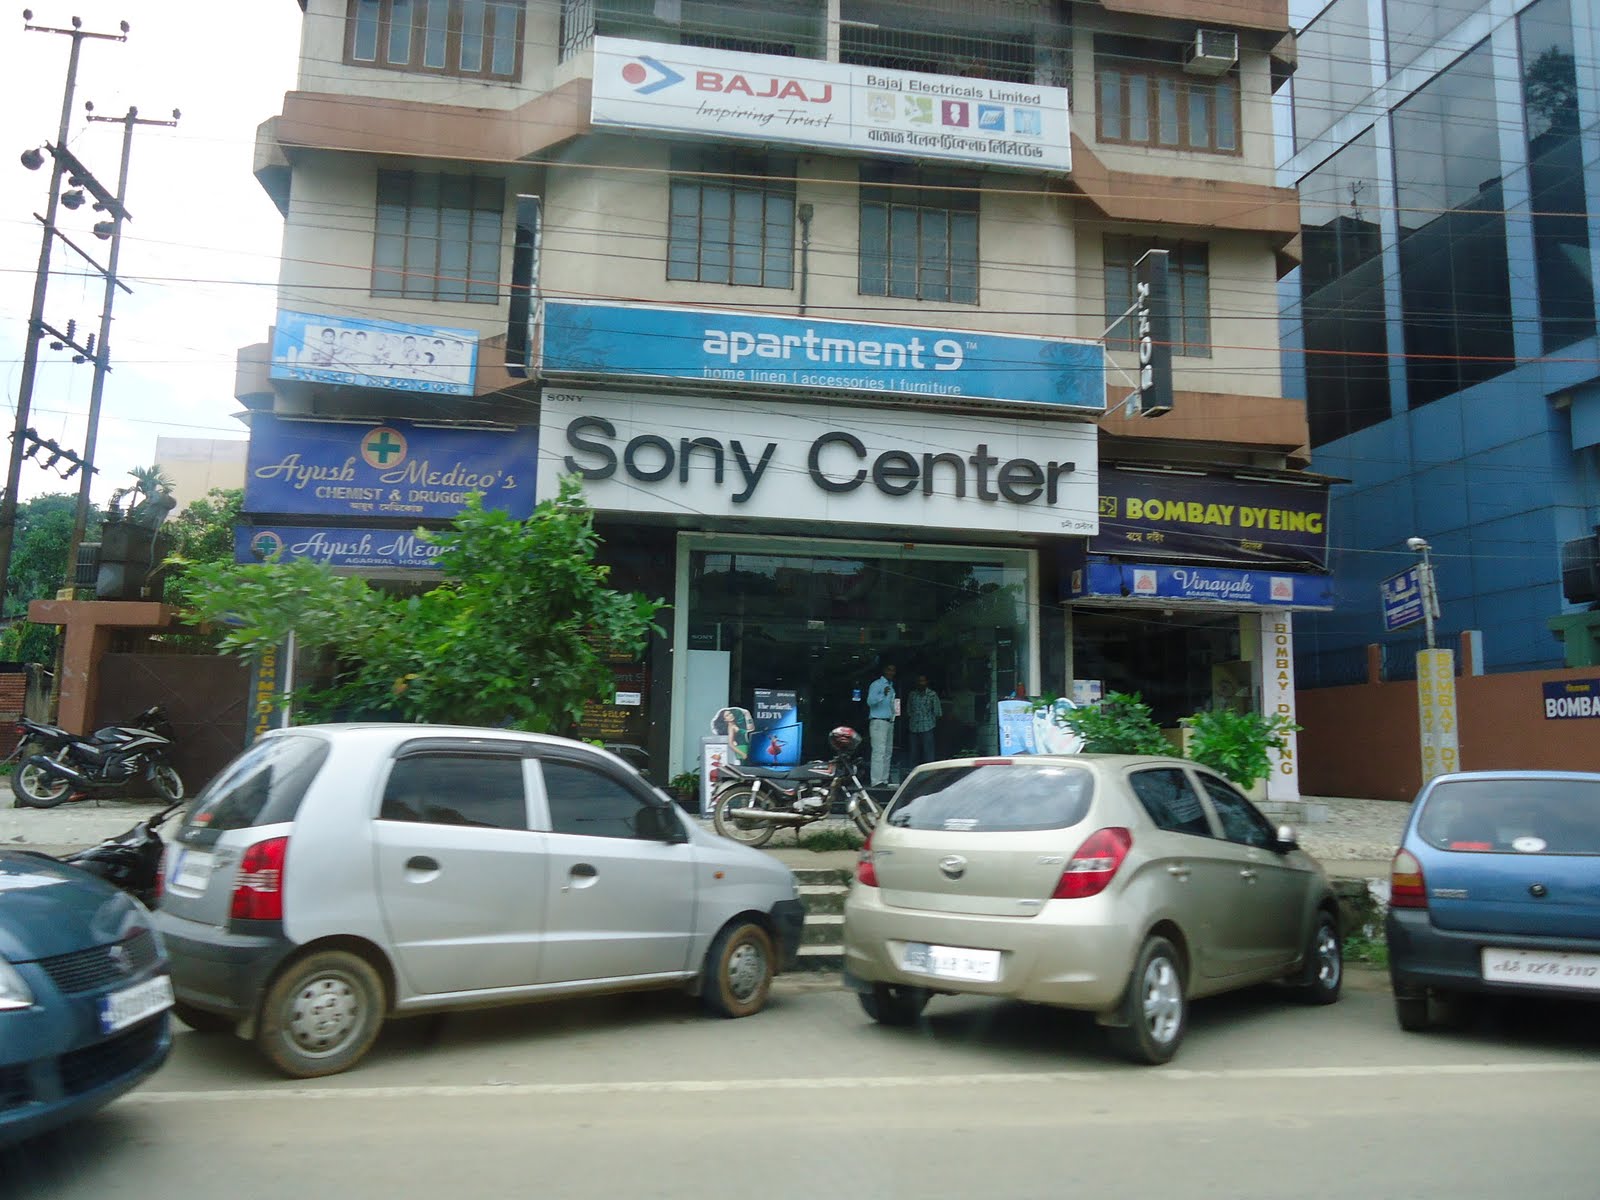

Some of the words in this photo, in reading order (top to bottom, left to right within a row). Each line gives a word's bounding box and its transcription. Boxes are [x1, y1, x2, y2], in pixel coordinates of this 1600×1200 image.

[696, 71, 833, 104] BAJAJ
[867, 75, 903, 92] Bajaj
[909, 79, 983, 99] Electricals
[989, 89, 1041, 105] Limited
[696, 100, 775, 127] Inspiring
[778, 108, 832, 128] Trust
[868, 129, 905, 145] বাজাজ
[703, 328, 926, 370] apartment
[933, 339, 964, 371] 9
[703, 365, 745, 381] home
[750, 367, 786, 384] linen
[801, 373, 885, 391] accessories
[900, 378, 961, 396] furniture
[547, 393, 585, 402] SONY
[254, 453, 357, 490] Ayush
[380, 460, 518, 489] Medico's
[564, 415, 777, 504] Sony
[807, 430, 1076, 505] Center
[315, 486, 384, 502] CHEMIST
[388, 488, 402, 502] &
[1126, 496, 1236, 526] BOMBAY
[1239, 505, 1323, 535] DYEING
[290, 531, 372, 563] Ayush
[345, 557, 395, 566] AGARWAL
[399, 558, 436, 567] HOUSE
[1172, 569, 1254, 598] Vinayak
[1274, 623, 1289, 691] BOMBAY
[756, 702, 769, 710] The
